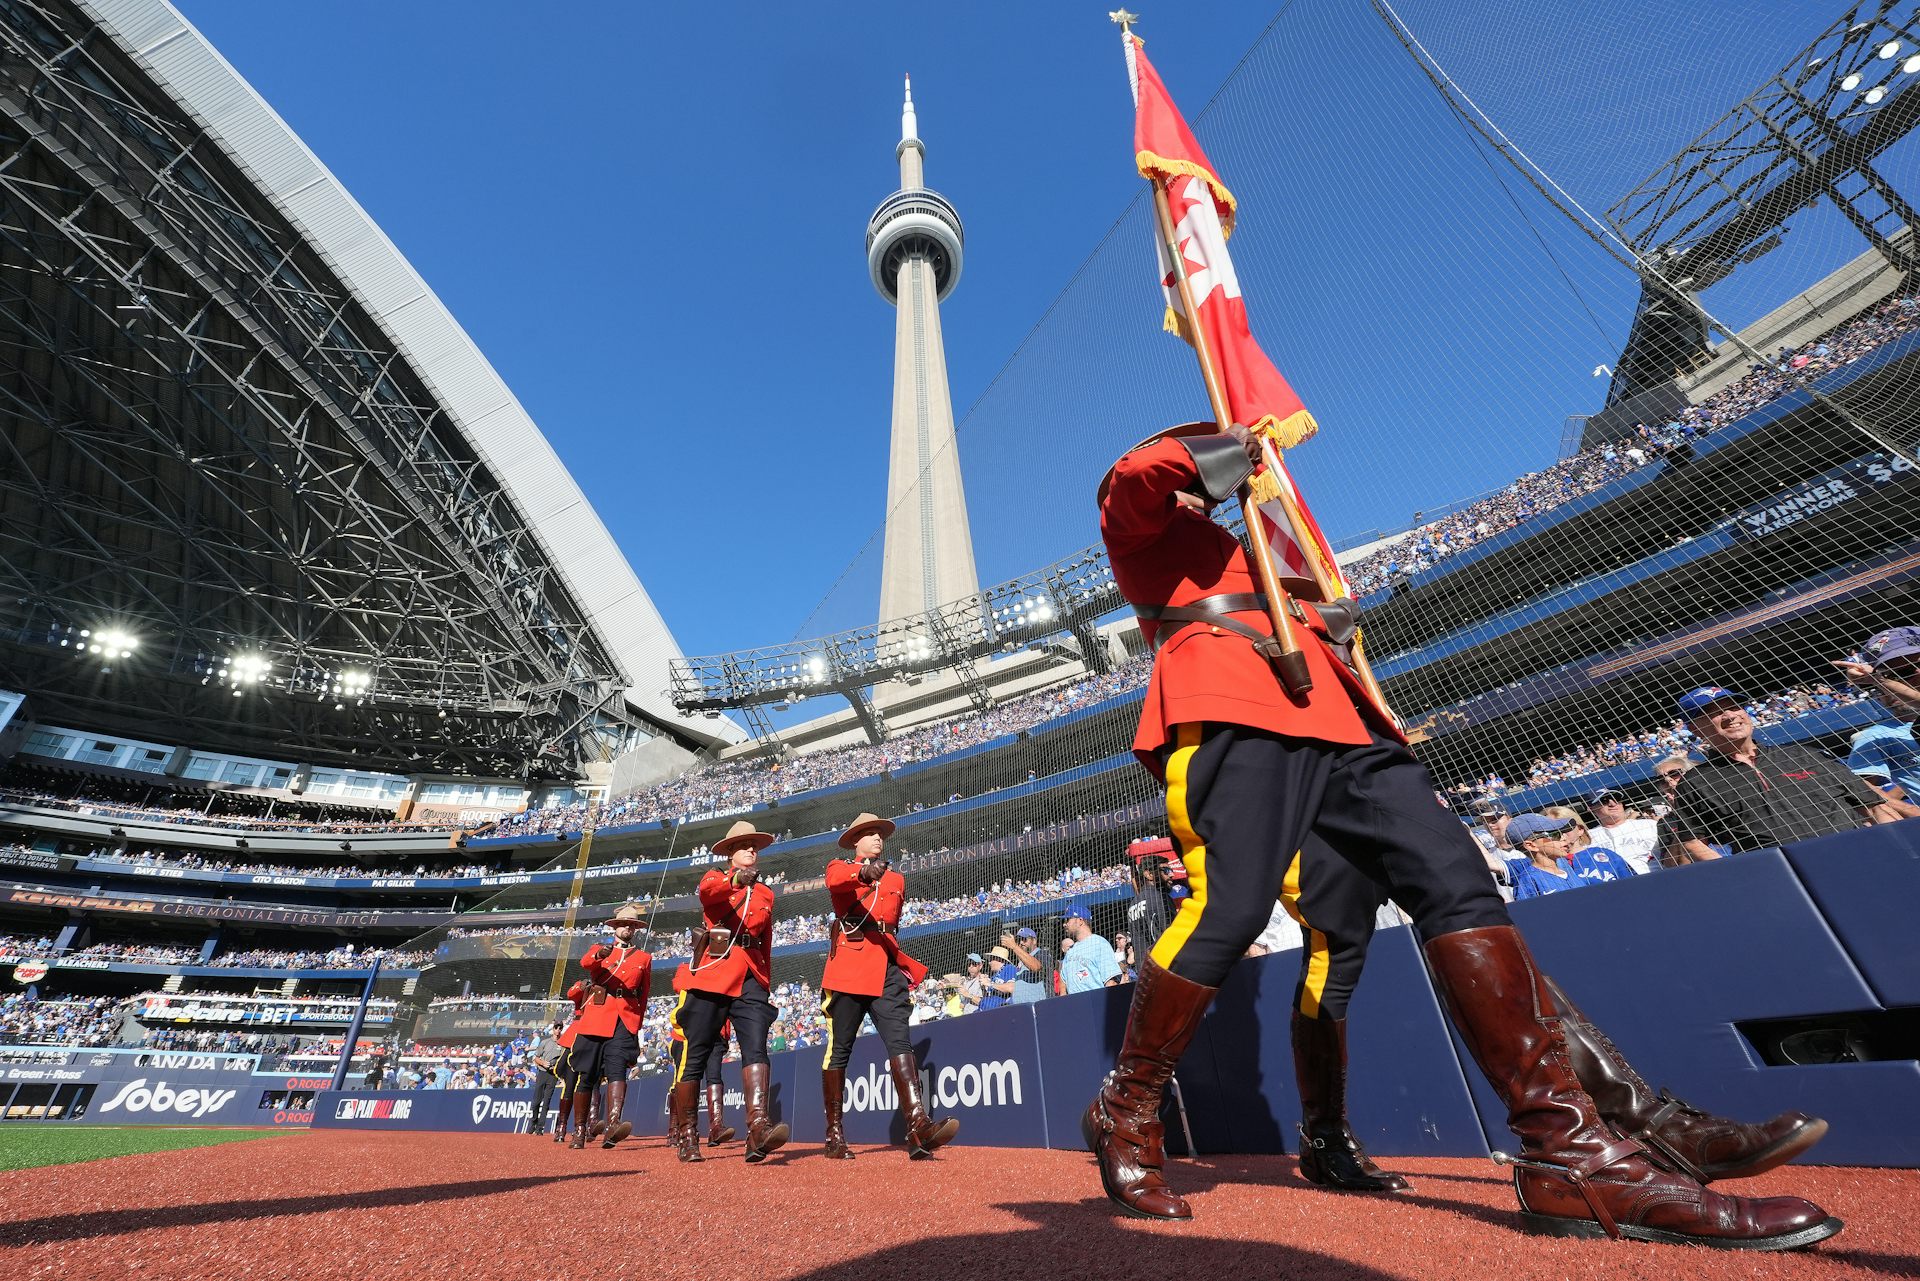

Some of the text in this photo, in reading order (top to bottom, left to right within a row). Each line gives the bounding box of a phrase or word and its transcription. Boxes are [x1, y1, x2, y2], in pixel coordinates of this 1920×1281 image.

[1744, 479, 1851, 527] WINNER
[1752, 488, 1858, 537] TAKES HOME
[460, 810, 505, 821] ROOFTO
[688, 810, 714, 823] JACKIE
[714, 804, 753, 818] ROBINSON
[899, 805, 1142, 874] CEREMONIAL FIRST PITCH
[134, 867, 184, 878] DAVE STIEB
[252, 875, 306, 886] CITO GASTON
[480, 876, 531, 886] PAUL BEESTON
[585, 869, 601, 878] ROY
[601, 866, 638, 877] HALLADAY
[9, 891, 380, 925] KEVIN PILLAR CEREMONIAL FIRST PITCH
[56, 960, 110, 969] BLEACHERS
[143, 1000, 246, 1021] theScore
[260, 1007, 298, 1023] BET
[300, 1012, 348, 1021] SPORTSBOOK
[99, 1078, 237, 1118] Sobeys
[354, 1099, 412, 1119] PLAYBALL.ORG
